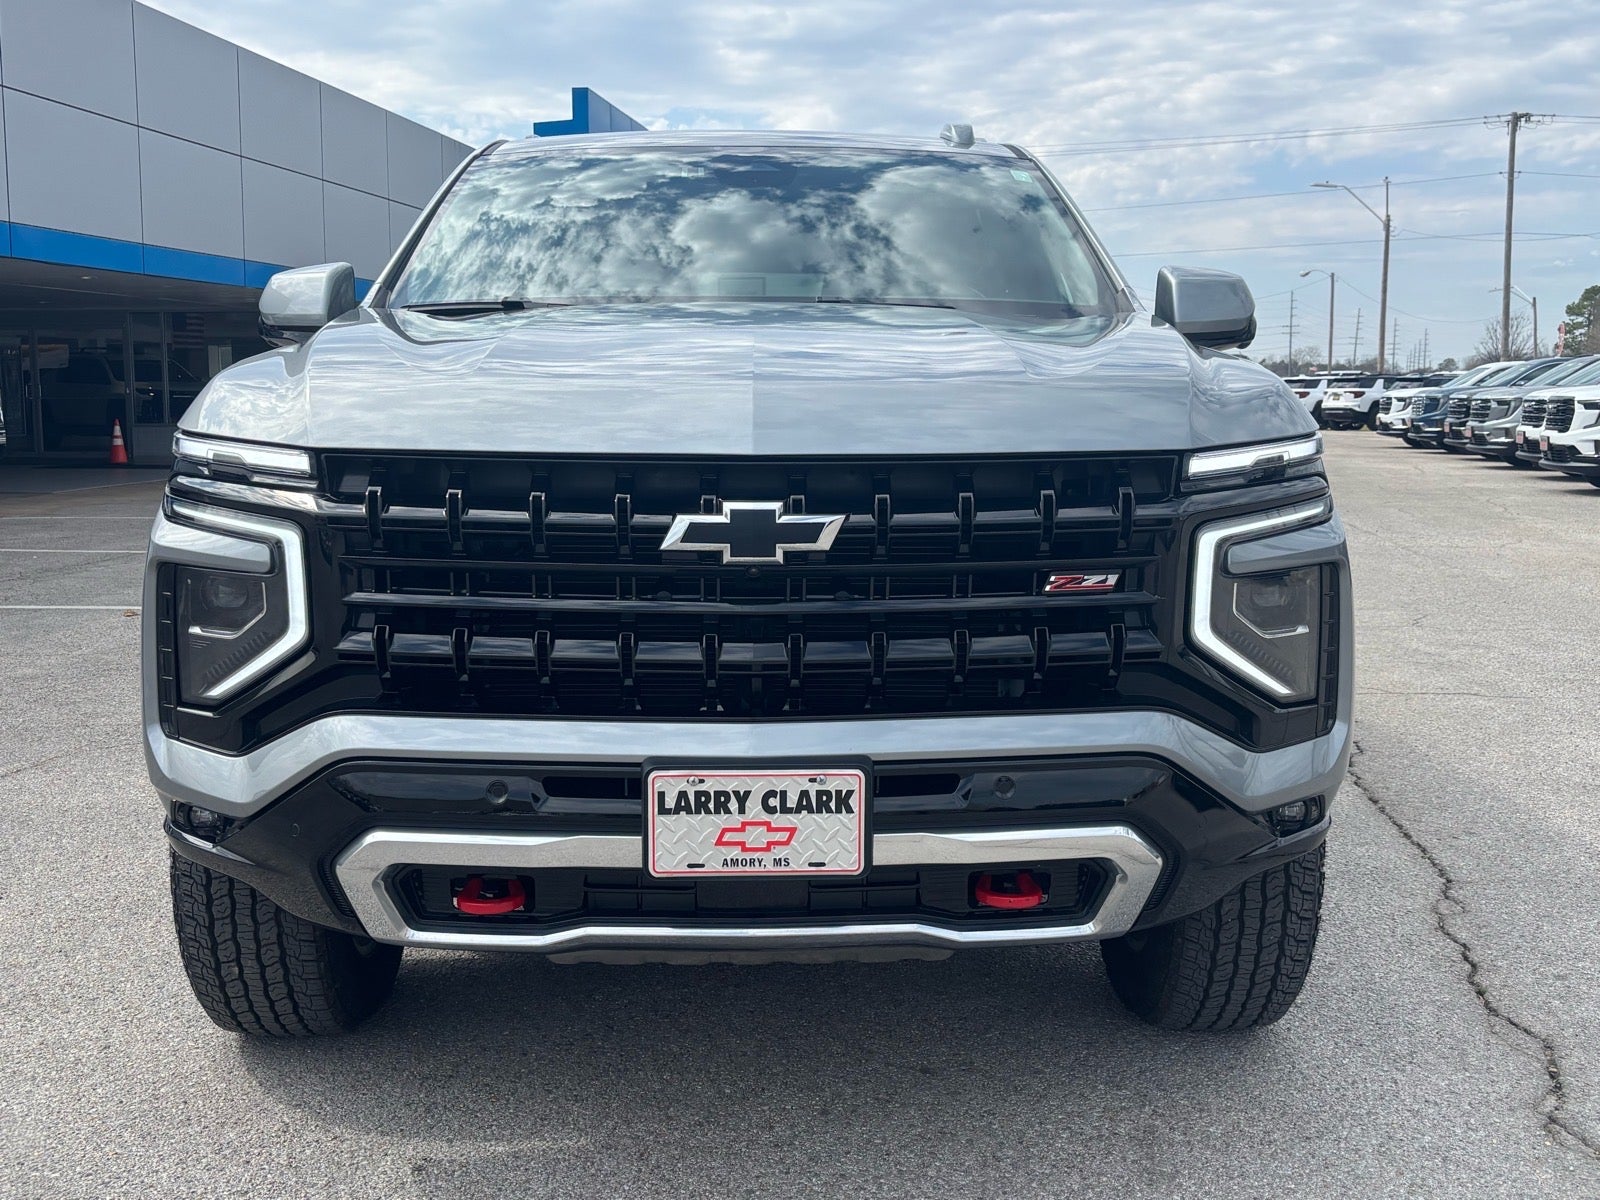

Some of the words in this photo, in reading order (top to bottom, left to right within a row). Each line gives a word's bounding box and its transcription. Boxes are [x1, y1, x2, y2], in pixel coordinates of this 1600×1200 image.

[1045, 575, 1119, 591] Z71
[657, 790, 752, 815] LARRY
[761, 789, 855, 815] CLARK
[722, 858, 767, 869] AMORY,
[773, 858, 790, 867] MS
